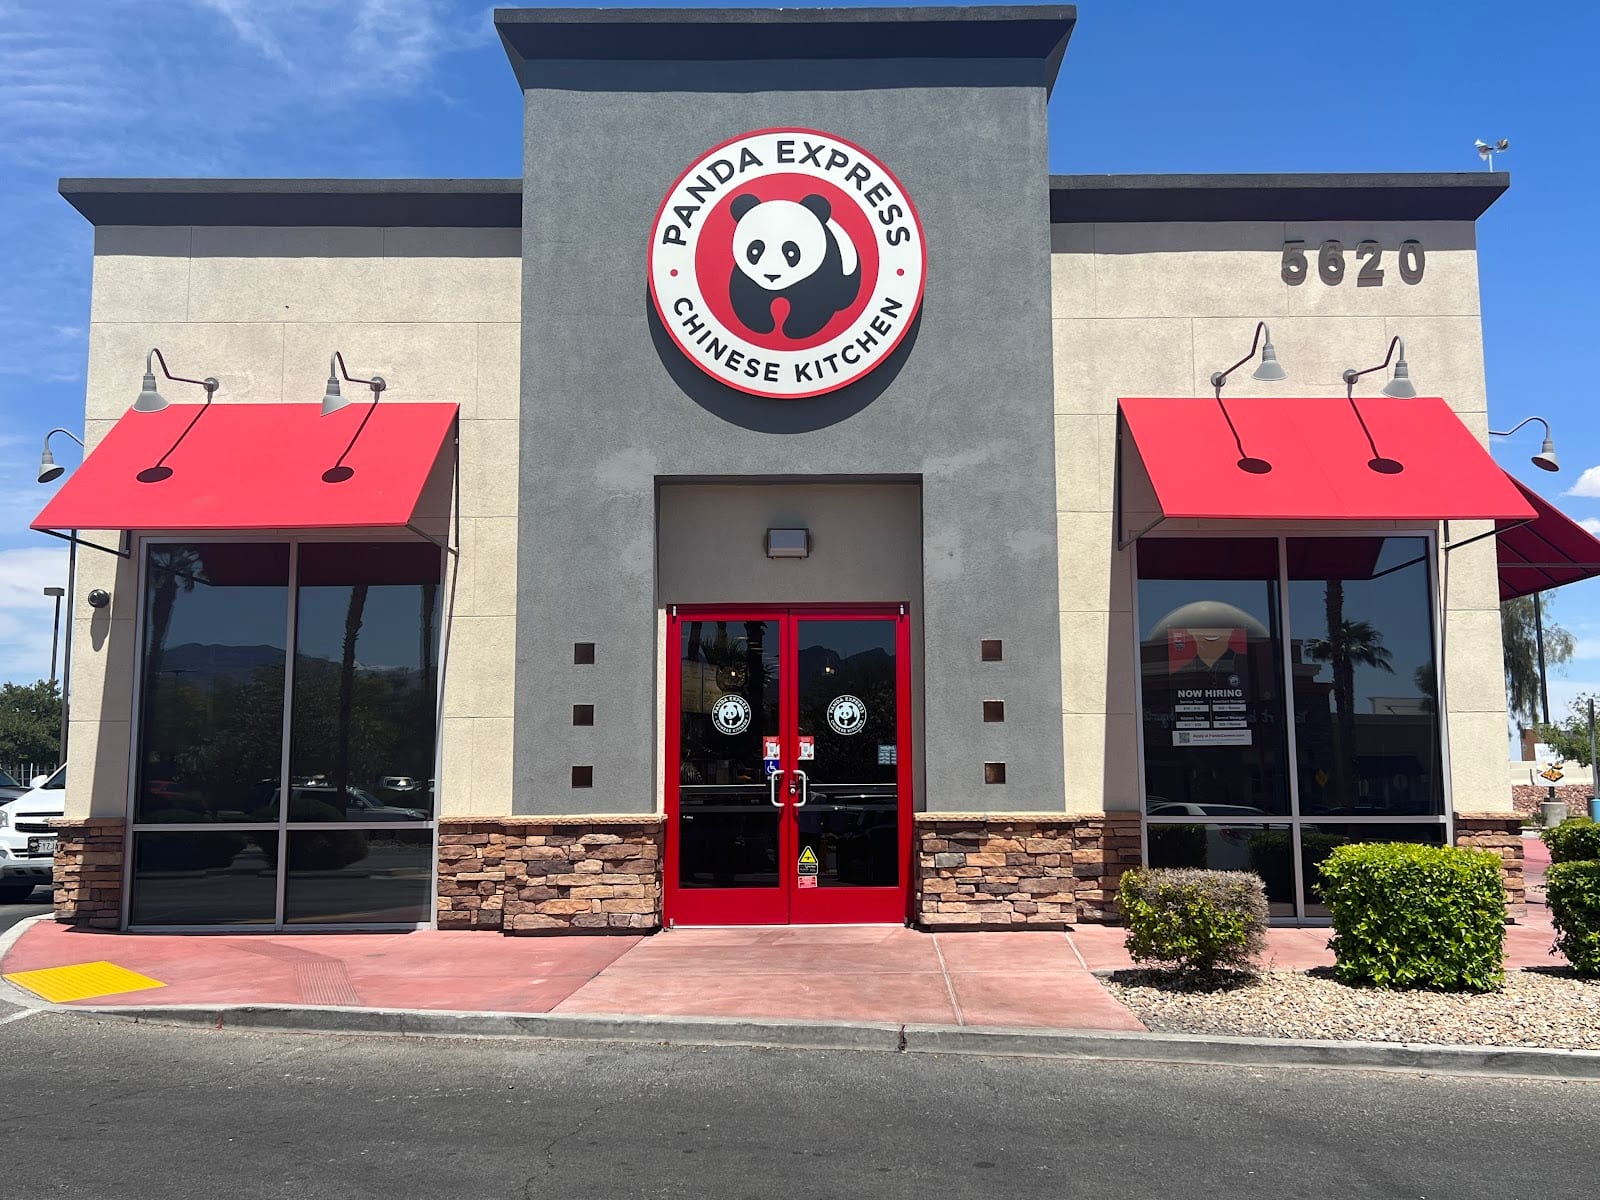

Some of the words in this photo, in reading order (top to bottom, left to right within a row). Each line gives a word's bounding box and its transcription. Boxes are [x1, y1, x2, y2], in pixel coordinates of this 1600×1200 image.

[662, 147, 763, 246] PANDA
[776, 140, 910, 246] EXPRESS
[1281, 239, 1425, 286] 5620
[673, 297, 780, 382] CHINESE
[794, 297, 902, 382] KITCHEN
[1177, 689, 1202, 698] NOW
[1205, 689, 1243, 697] HIRING
